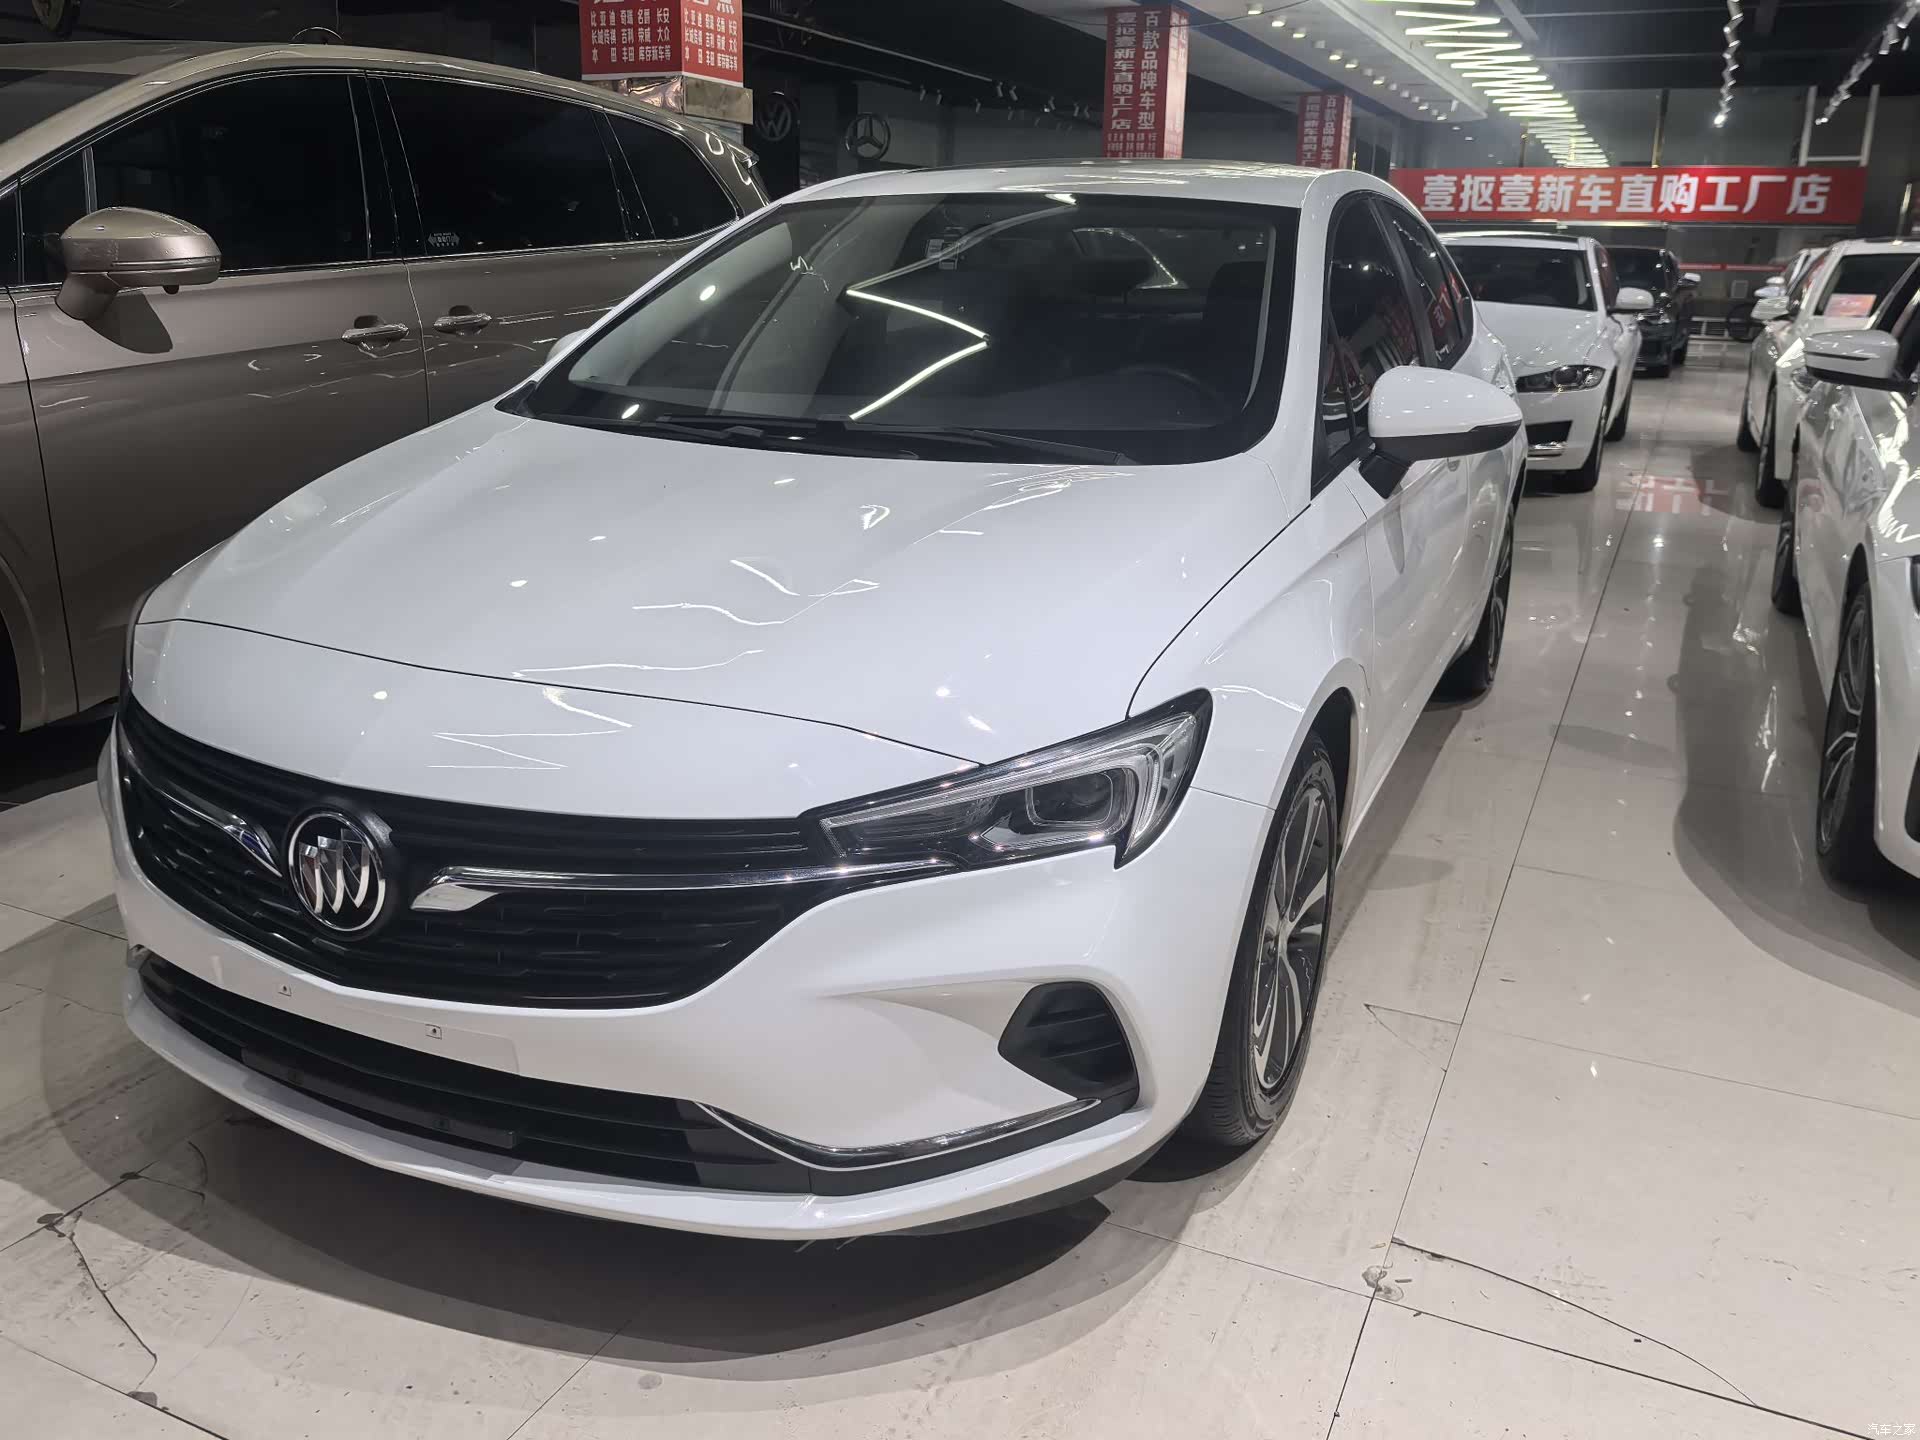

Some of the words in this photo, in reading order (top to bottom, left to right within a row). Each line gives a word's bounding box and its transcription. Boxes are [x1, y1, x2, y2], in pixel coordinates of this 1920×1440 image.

[656, 7, 670, 24] 长安
[657, 26, 670, 42] 大众
[1137, 11, 1161, 130] 百款品牌车型
[1421, 174, 1833, 216] 壹抠壹新车直购工厂店
